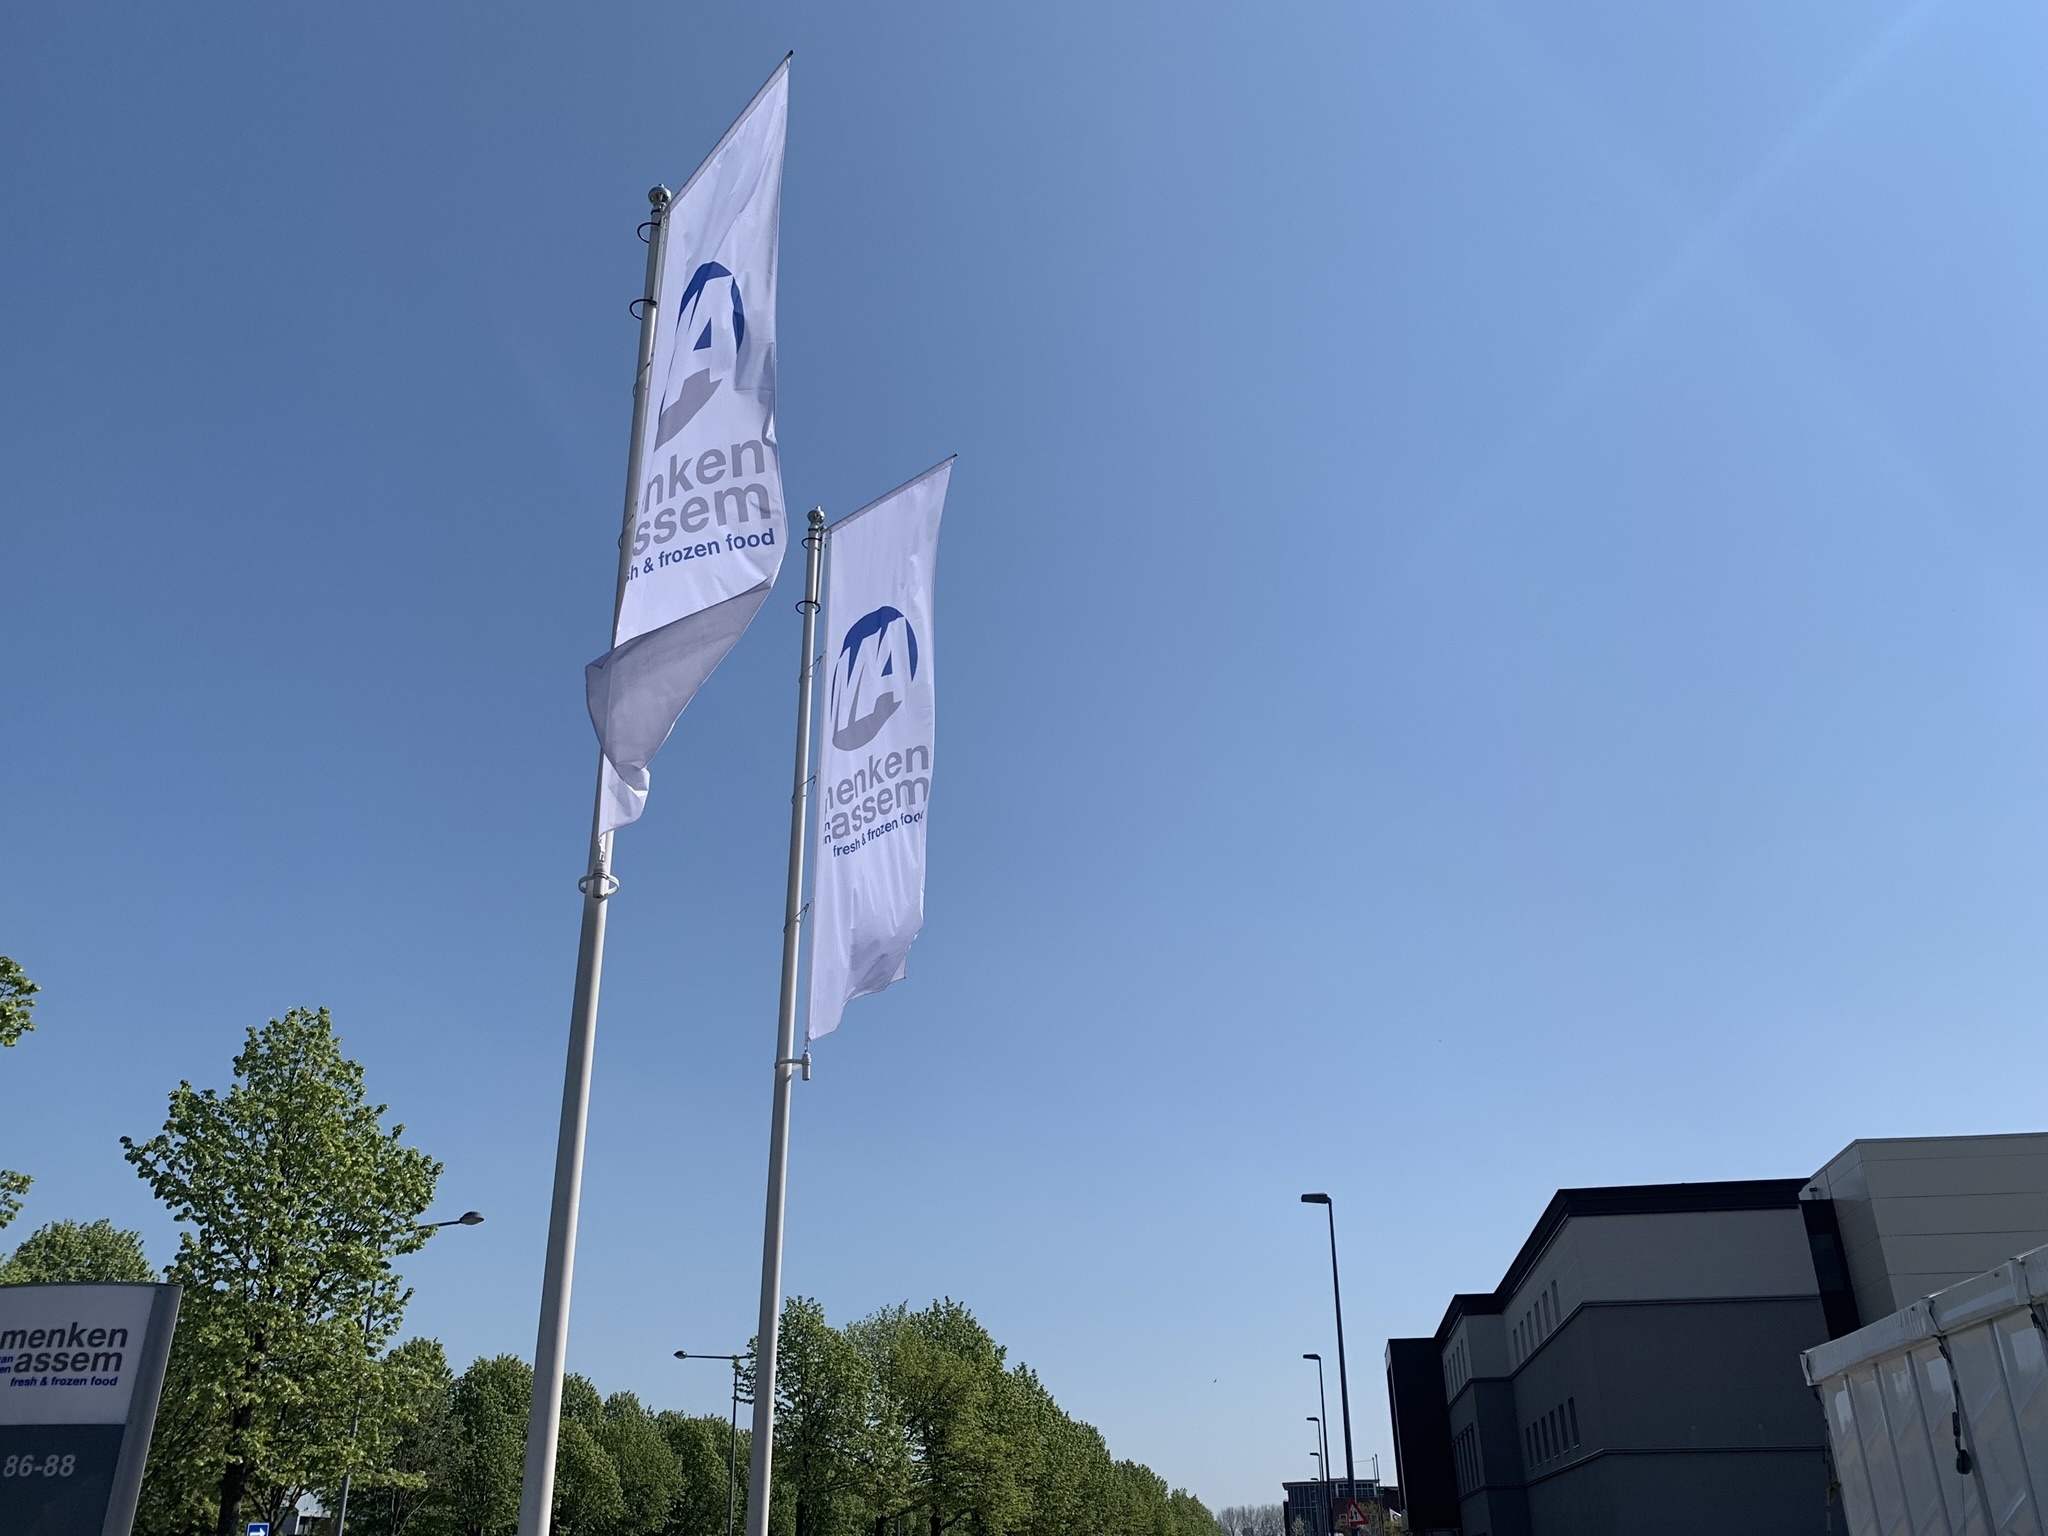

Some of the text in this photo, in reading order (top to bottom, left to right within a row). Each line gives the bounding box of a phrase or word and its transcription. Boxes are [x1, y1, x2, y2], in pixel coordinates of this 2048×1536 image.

[642, 439, 766, 514] nken
[632, 483, 772, 557] ssem
[643, 557, 655, 574] &
[658, 540, 721, 568] frozen
[725, 528, 775, 551] food
[831, 776, 930, 840] assem
[832, 838, 861, 857] fresh
[867, 819, 899, 841] frozen
[0, 1322, 128, 1349] menken
[10, 1376, 118, 1387] fresh & frozen food
[13, 1351, 123, 1374] assem
[2, 1454, 77, 1478] 86-88
